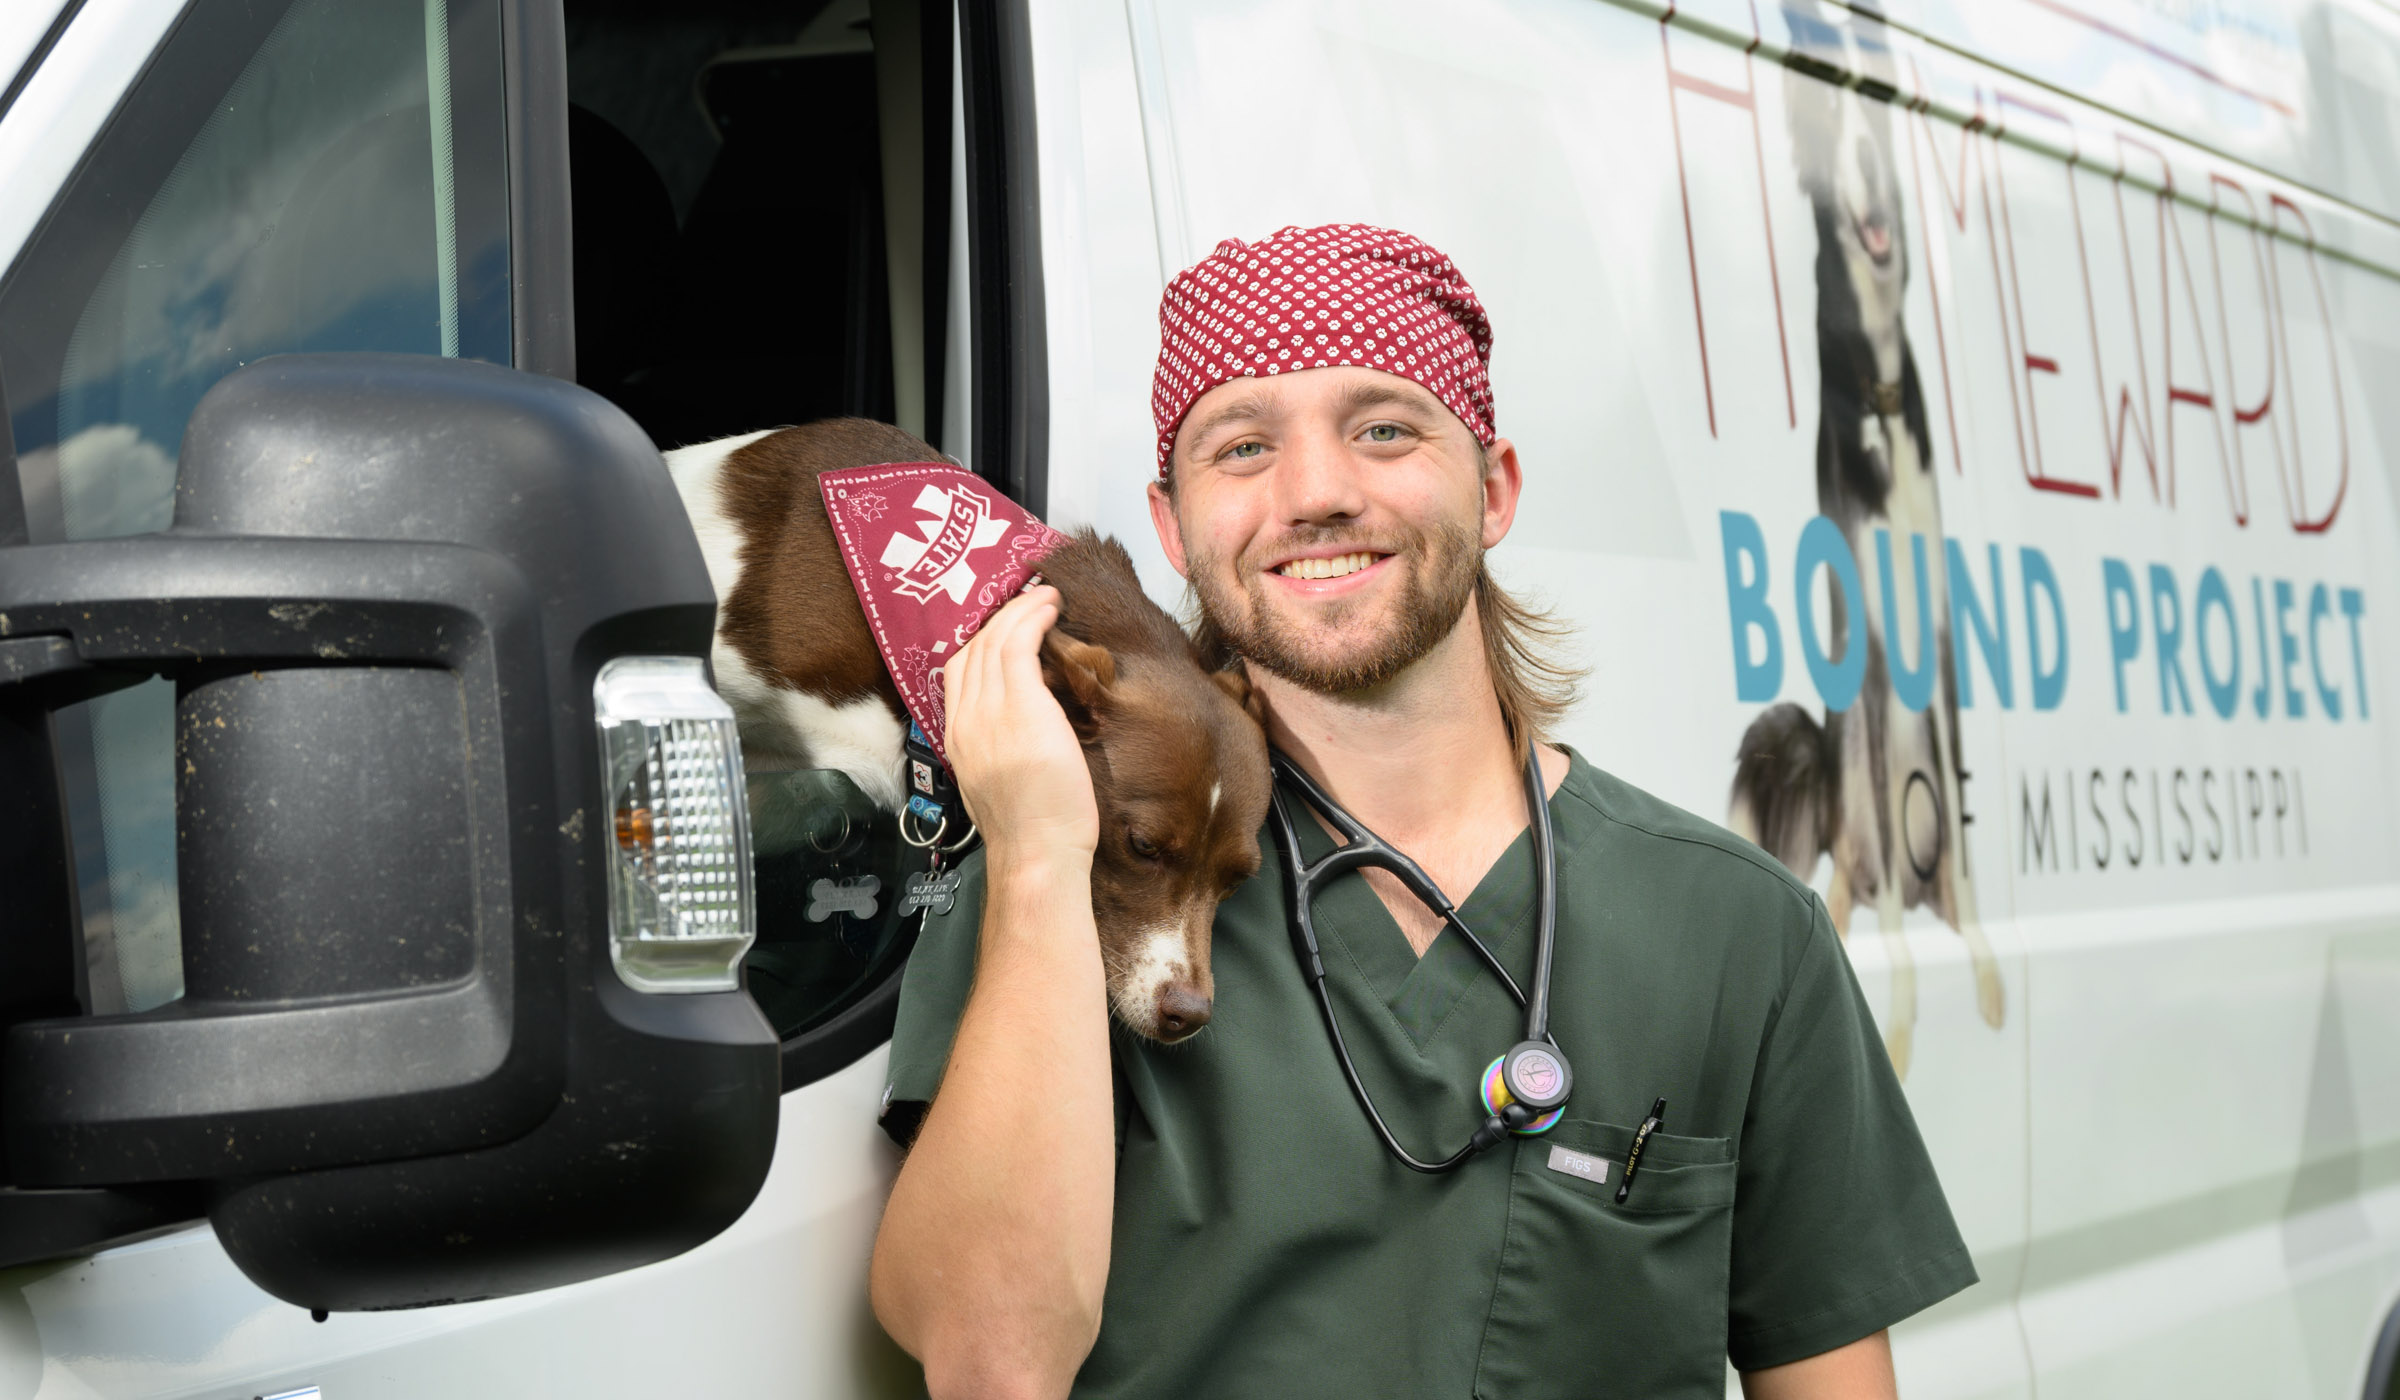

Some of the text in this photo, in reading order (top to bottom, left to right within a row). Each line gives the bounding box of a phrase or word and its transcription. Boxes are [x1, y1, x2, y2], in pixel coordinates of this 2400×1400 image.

[913, 501, 976, 579] STATE
[1720, 510, 2370, 722] BOUND PROJECT
[2019, 765, 2310, 876] MISSISSIPPI
[1564, 1155, 1592, 1174] FIGS
[1632, 1137, 1643, 1155] G-2
